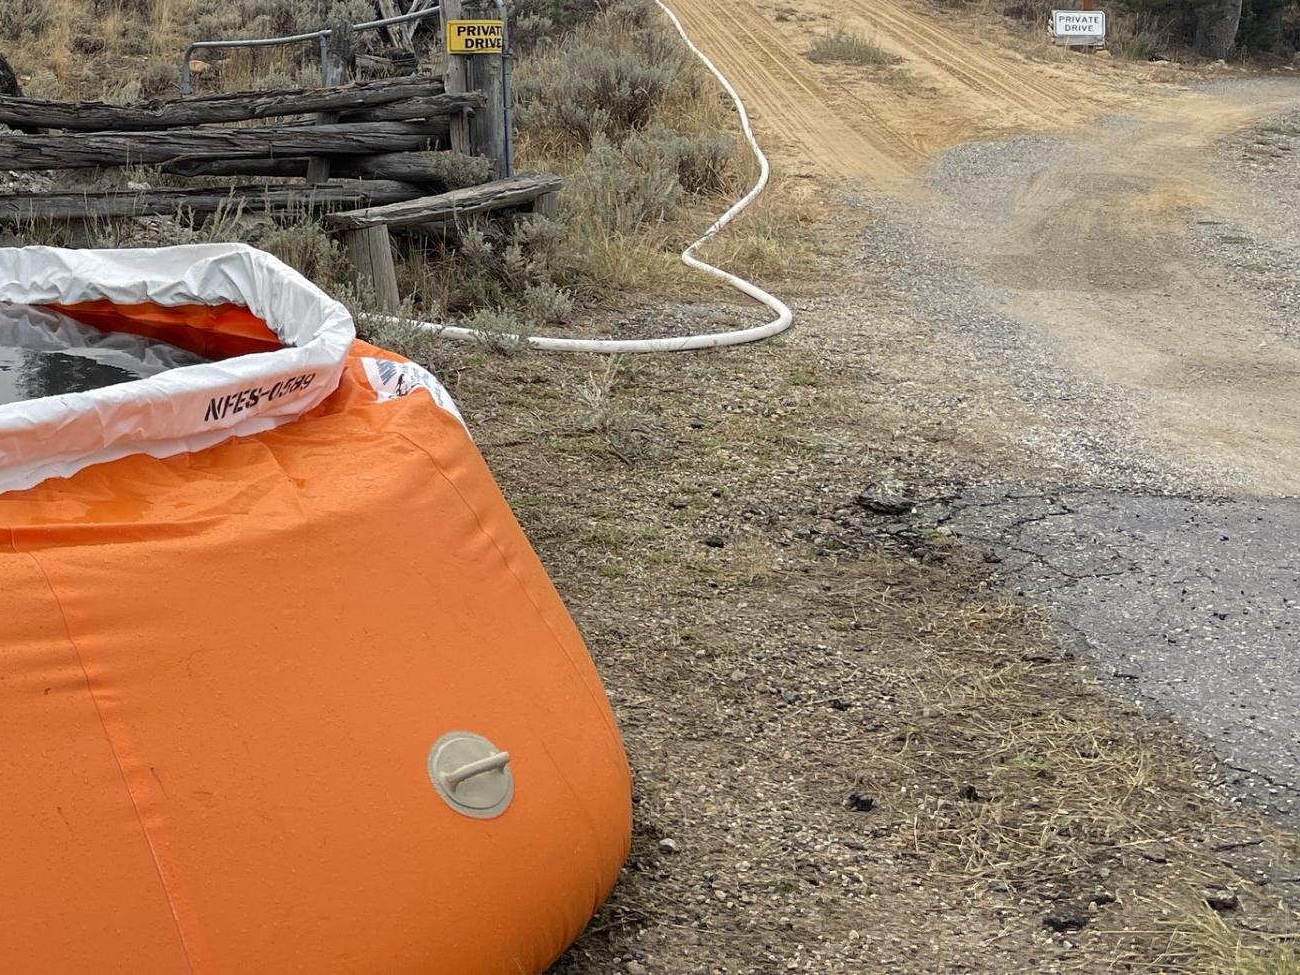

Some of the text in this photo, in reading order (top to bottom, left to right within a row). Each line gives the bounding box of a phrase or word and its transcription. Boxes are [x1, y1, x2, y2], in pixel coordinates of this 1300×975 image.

[1059, 15, 1100, 24] PRIVATE
[457, 26, 503, 36] PRIVAT
[1065, 24, 1094, 32] DRIVE
[465, 38, 502, 48] DRIVE
[204, 372, 316, 422] NFES-0589
